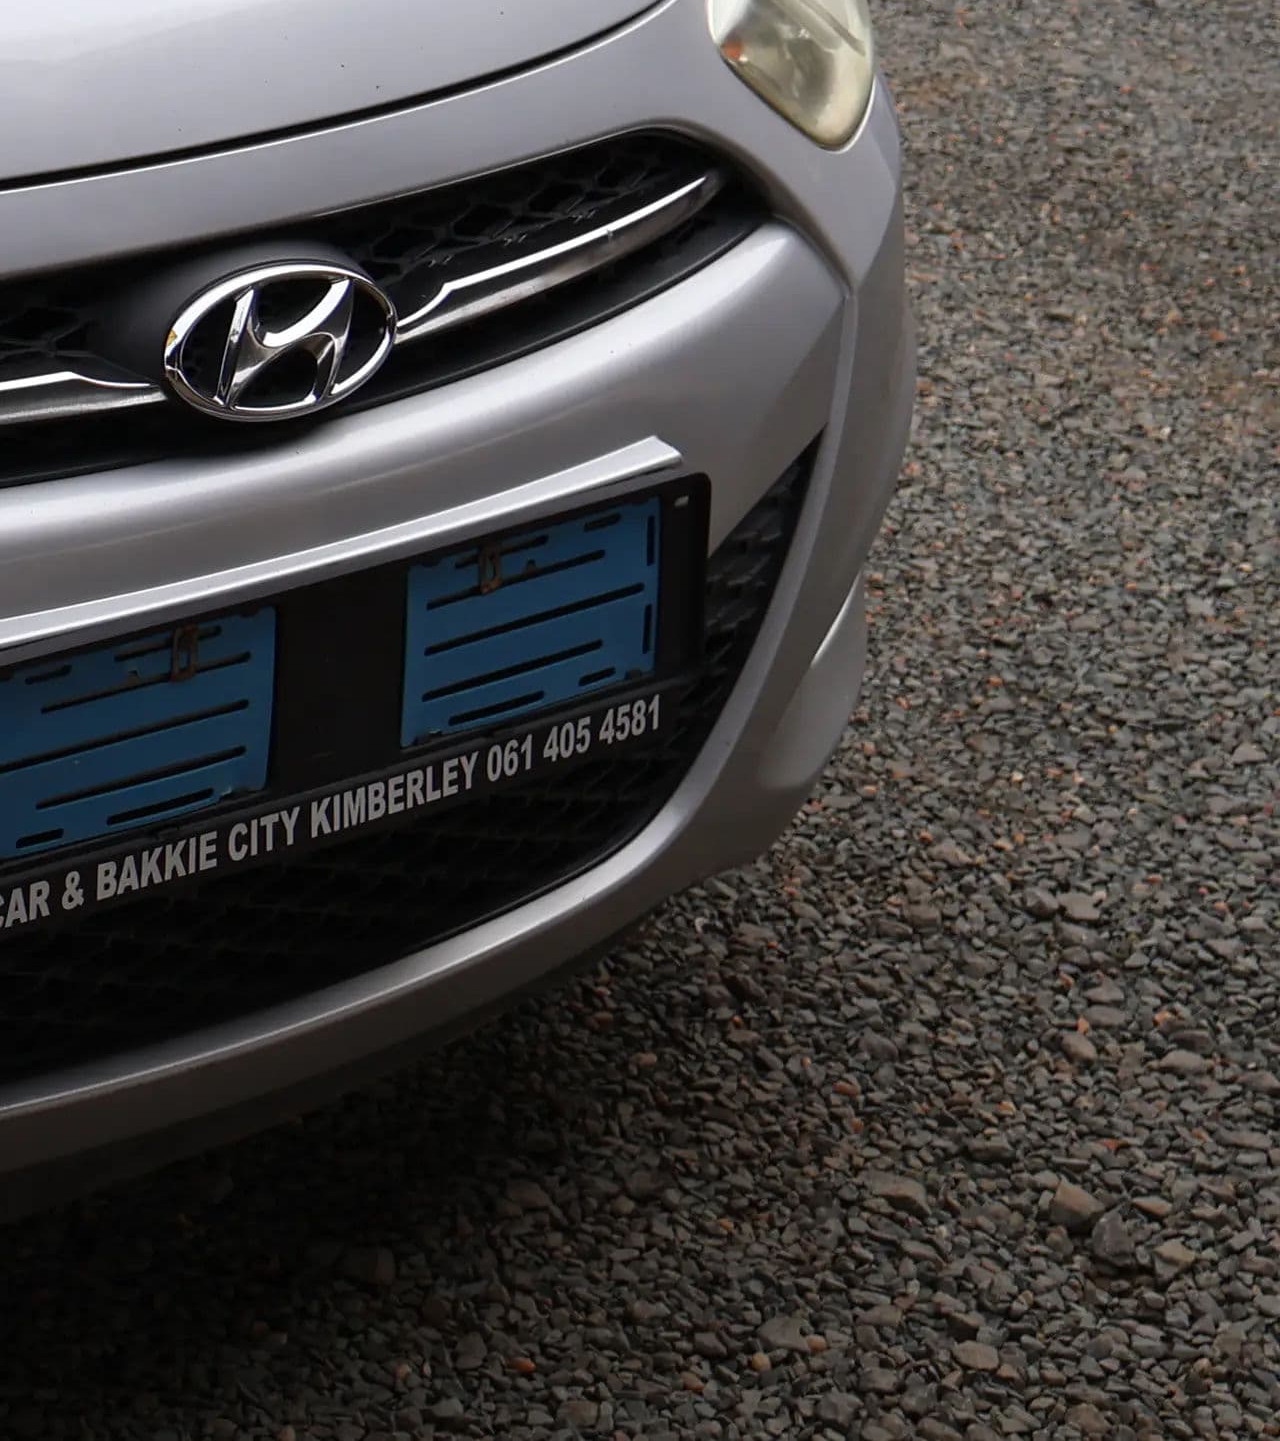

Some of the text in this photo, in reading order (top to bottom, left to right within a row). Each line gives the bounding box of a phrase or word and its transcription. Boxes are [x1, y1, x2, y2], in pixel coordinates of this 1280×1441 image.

[61, 870, 85, 910] &
[96, 830, 218, 902] BAKKIE
[228, 805, 301, 862] CITY
[310, 751, 479, 839] KIMBERLEY
[486, 734, 534, 793] 061
[543, 715, 591, 763] 405
[599, 693, 661, 746] 4581
